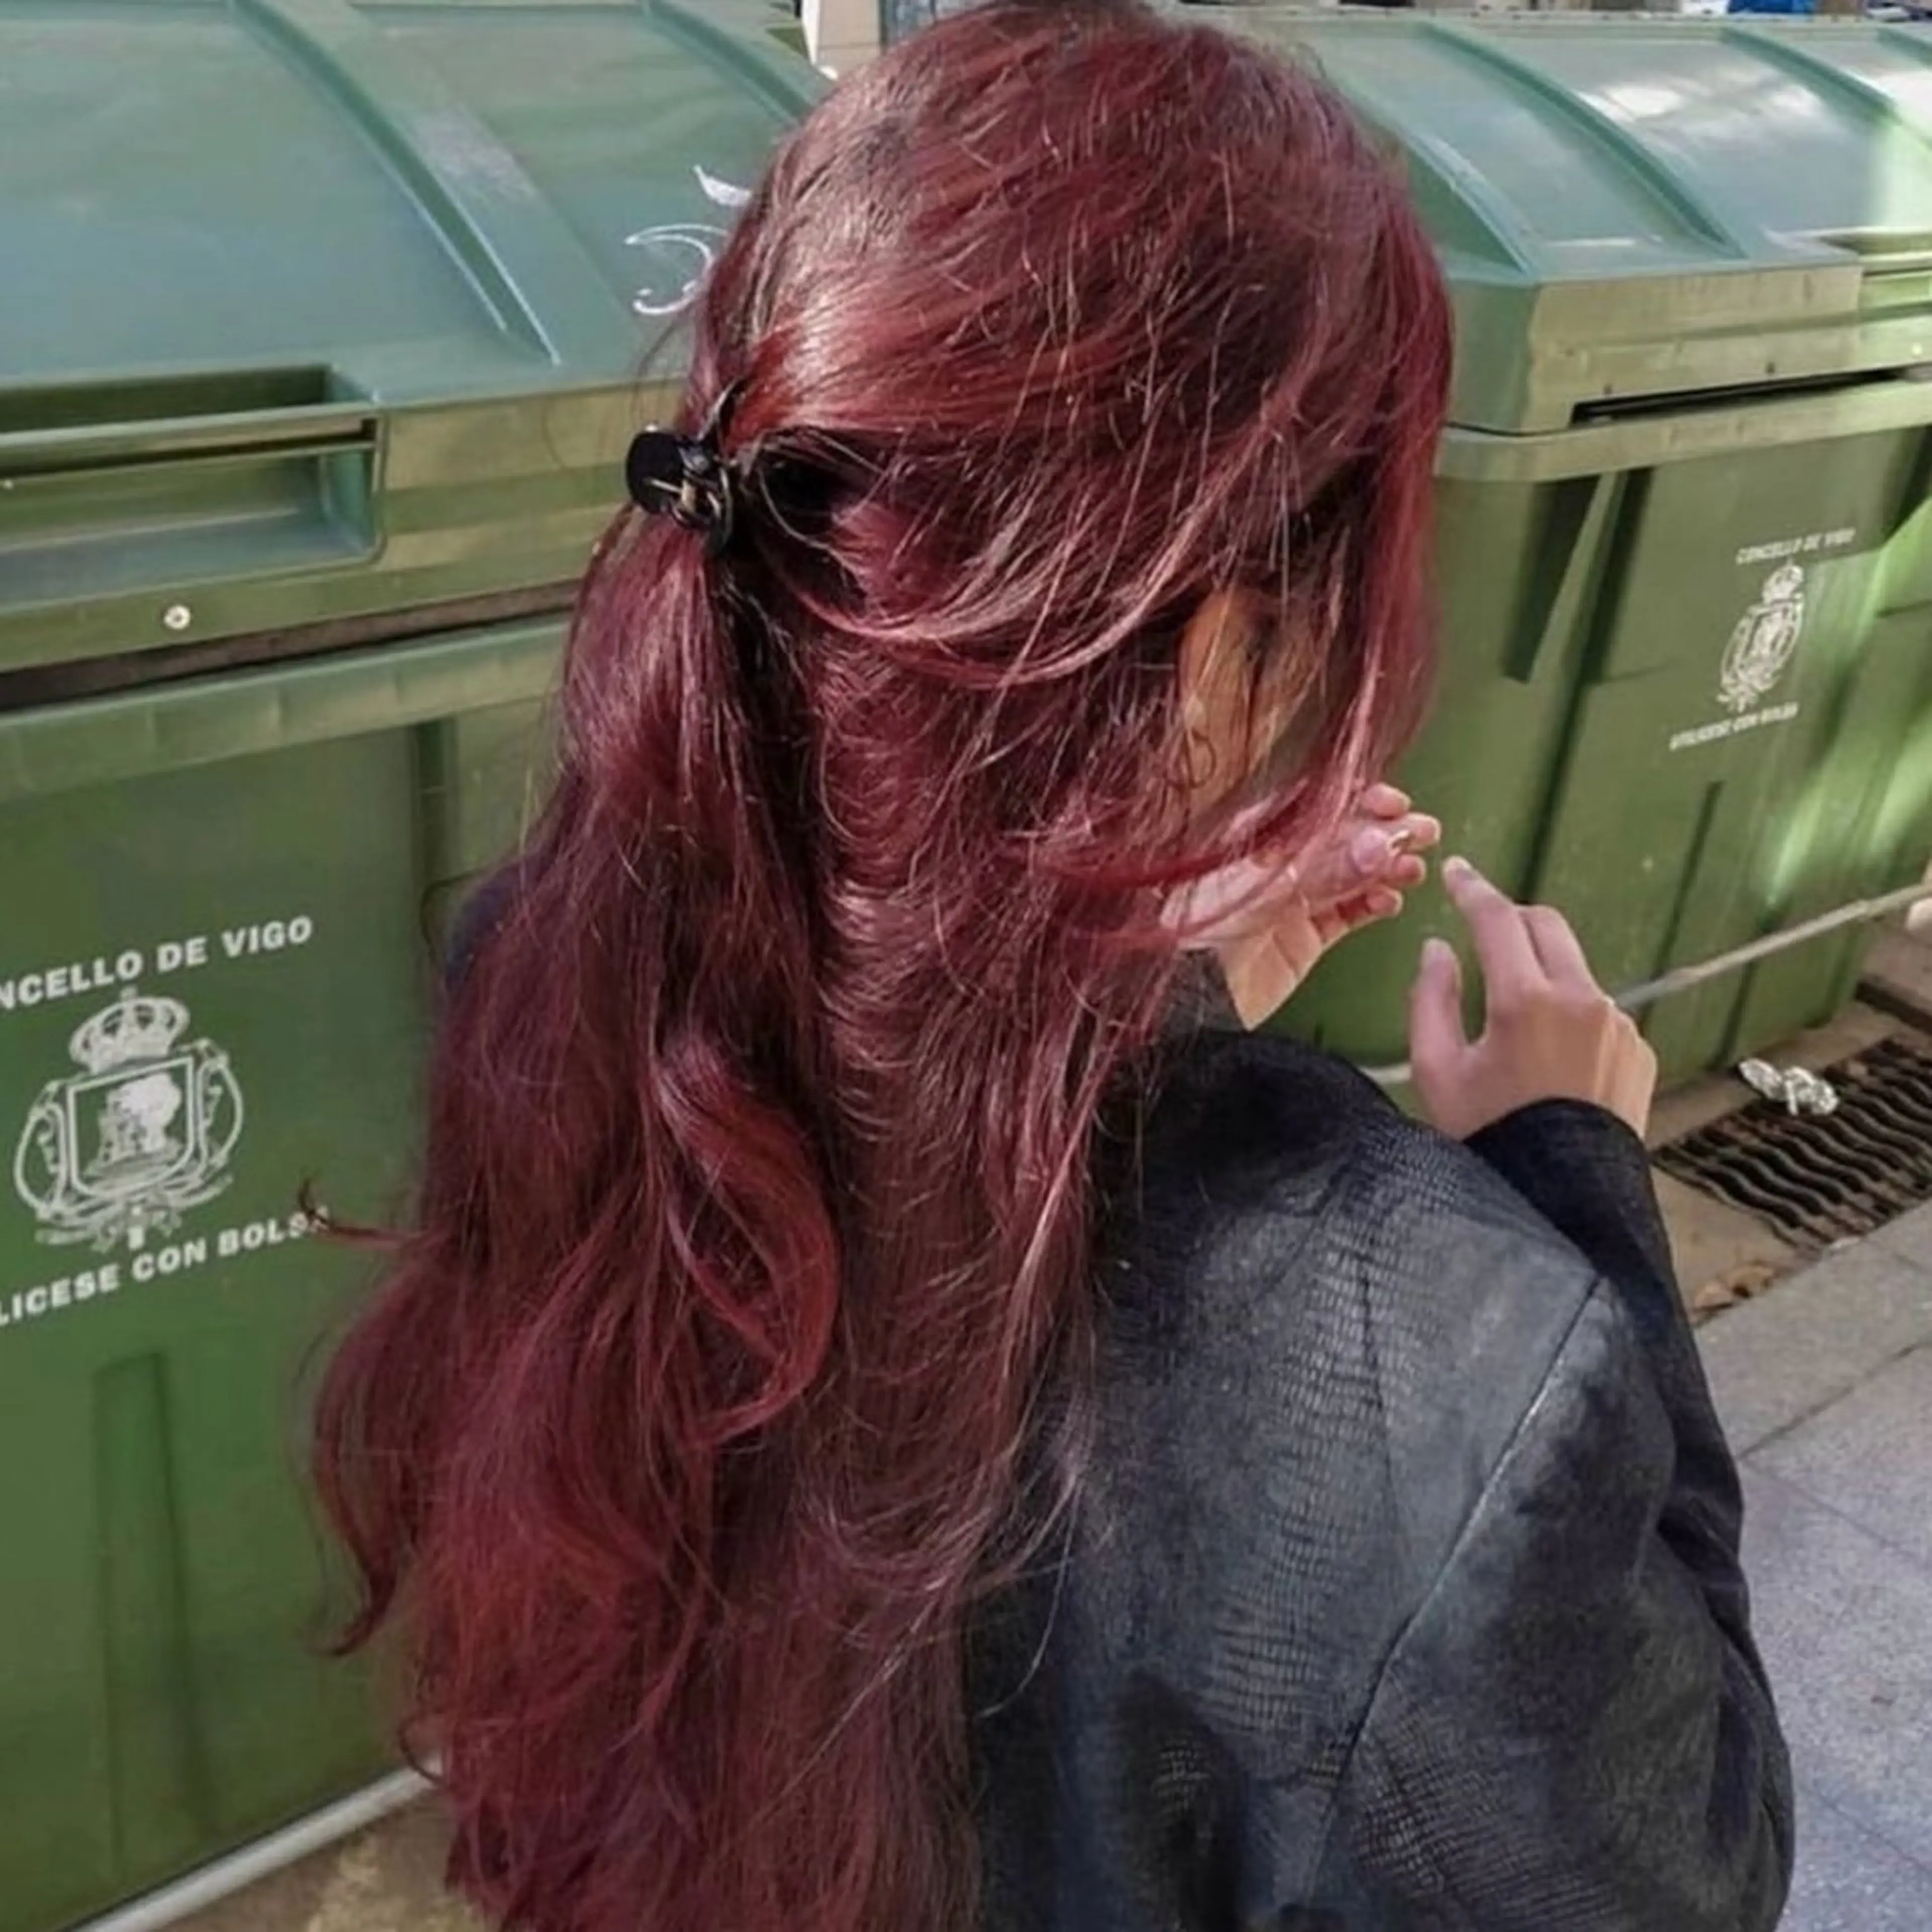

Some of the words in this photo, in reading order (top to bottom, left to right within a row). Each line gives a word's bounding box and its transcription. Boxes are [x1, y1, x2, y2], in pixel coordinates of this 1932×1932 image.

[156, 936, 208, 973] DE
[221, 915, 312, 957] VIGO
[131, 1237, 206, 1282] CON
